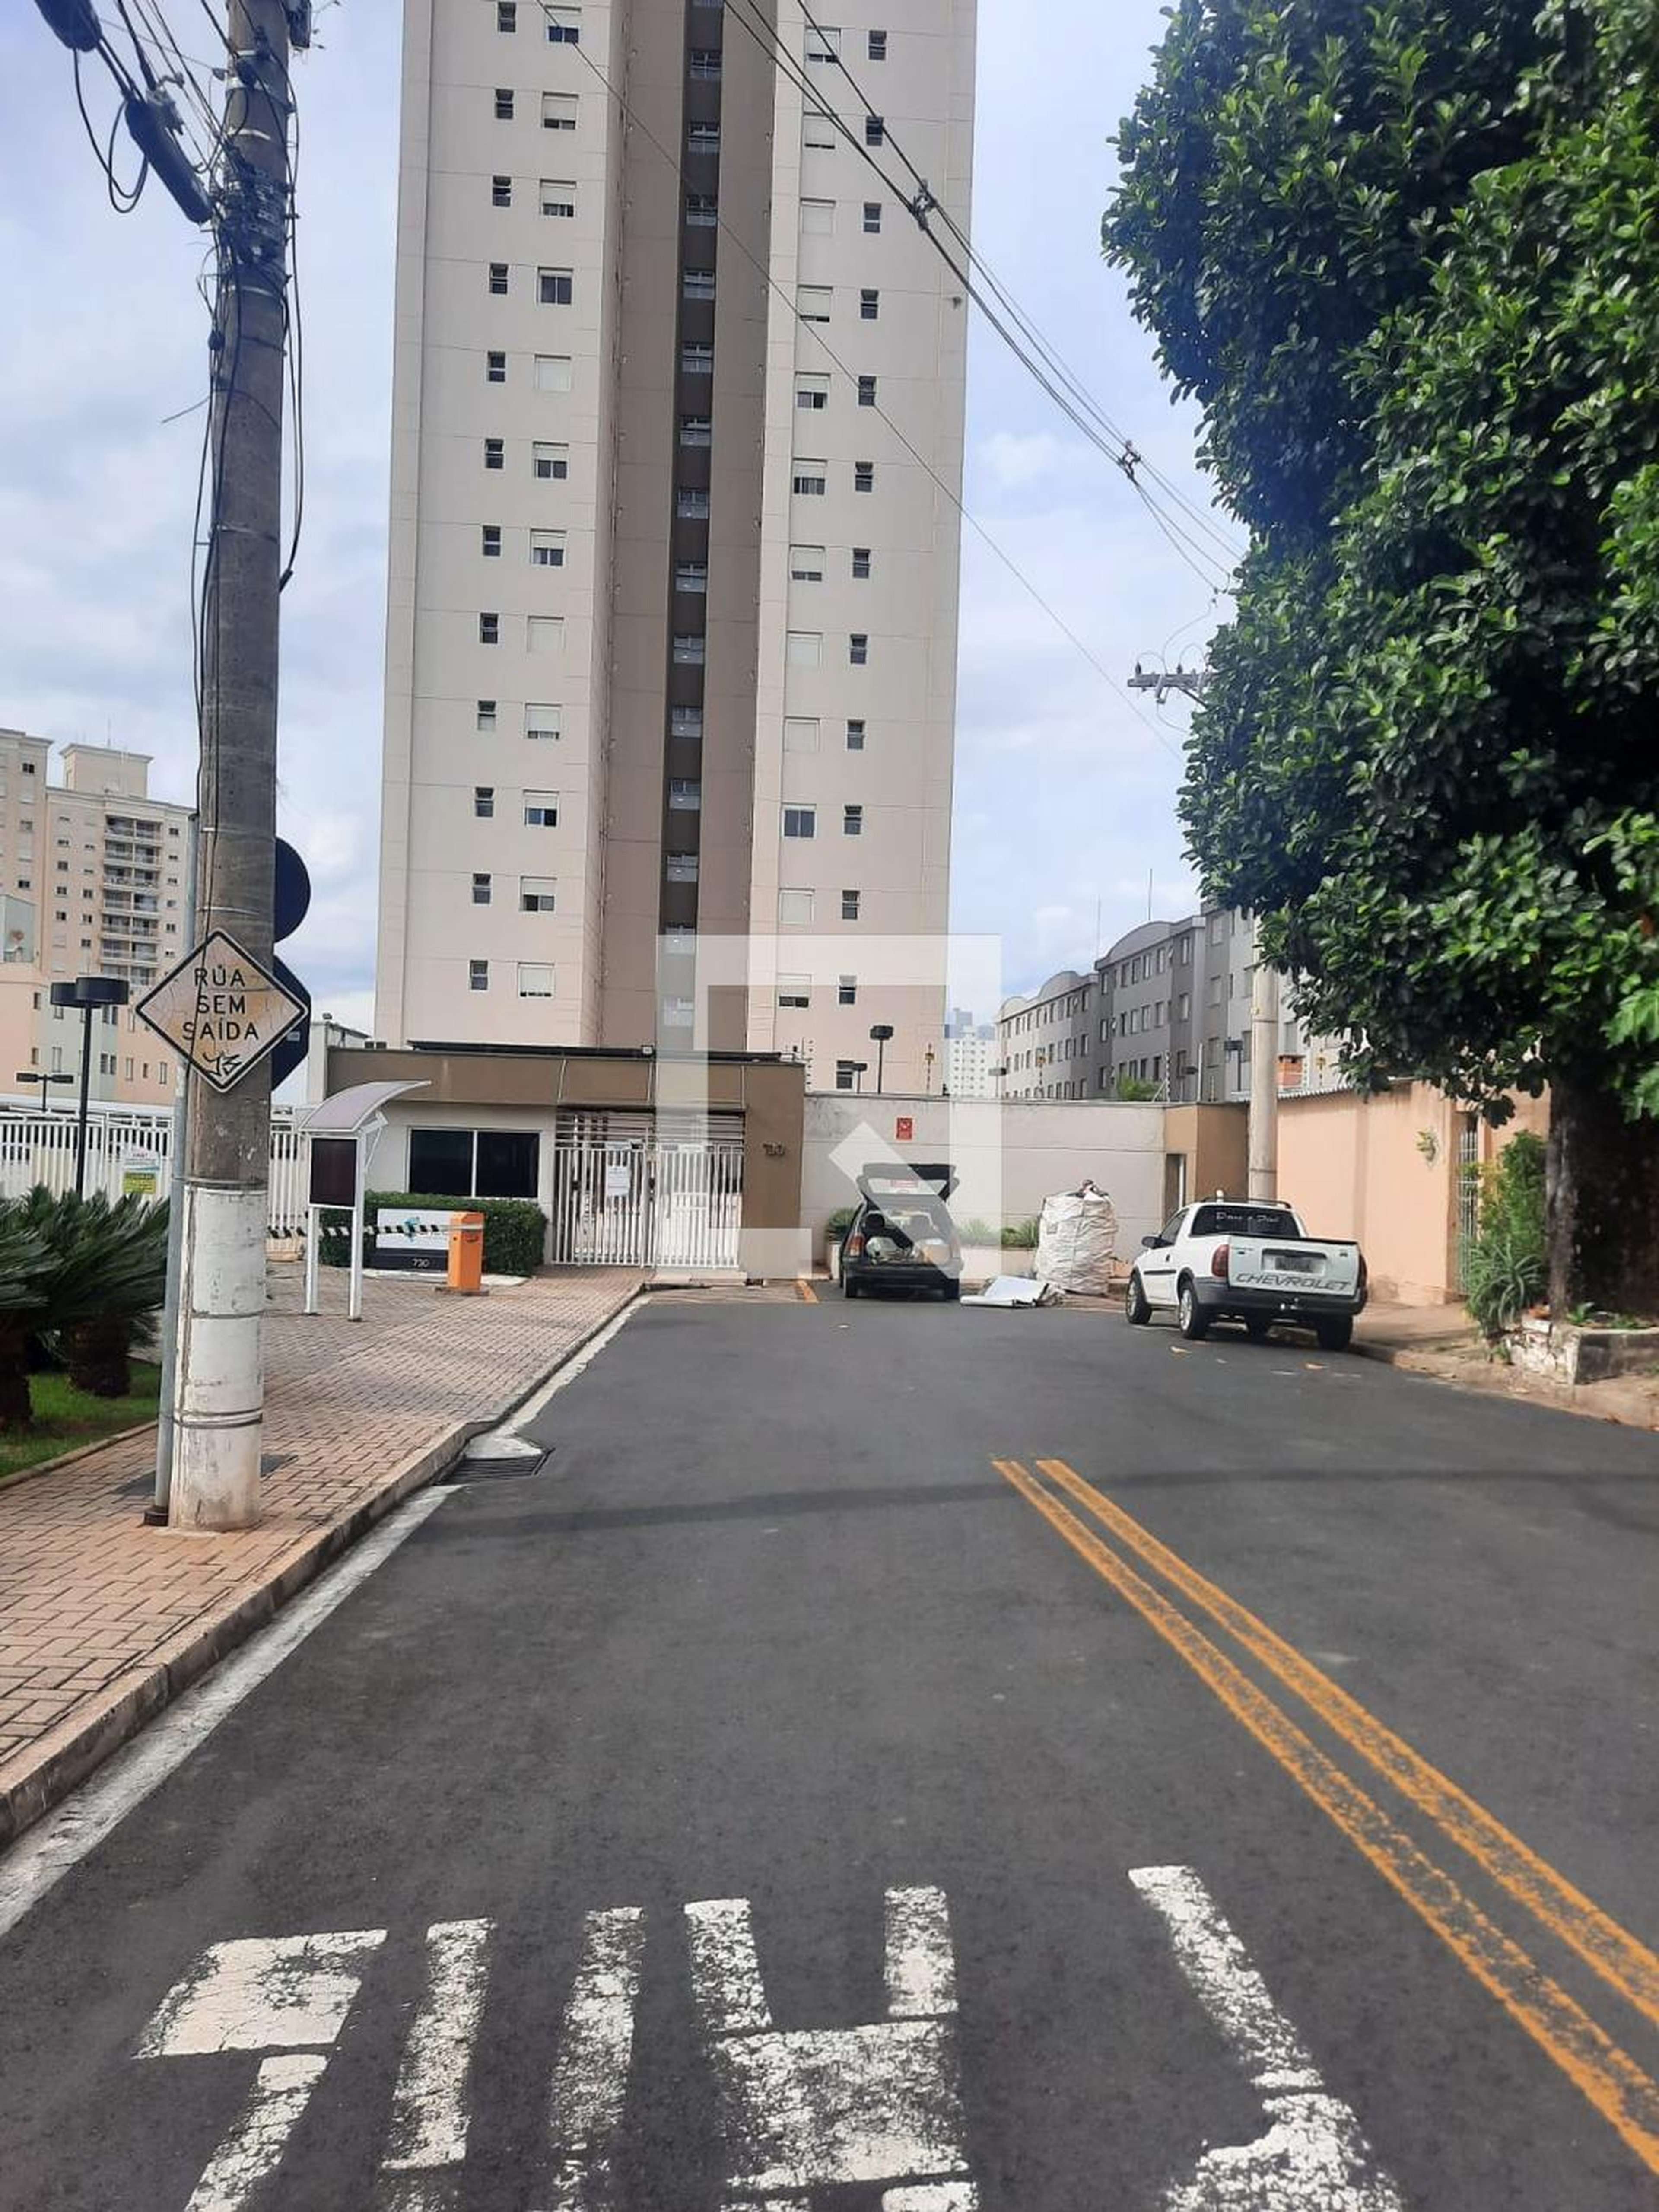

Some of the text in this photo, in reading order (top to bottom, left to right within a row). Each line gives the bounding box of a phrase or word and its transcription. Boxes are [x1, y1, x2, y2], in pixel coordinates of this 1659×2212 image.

[194, 968, 245, 987] RUA
[197, 995, 245, 1014] SEM
[183, 1018, 258, 1040] SAÍDA
[1236, 1273, 1351, 1291] CHEVROLET
